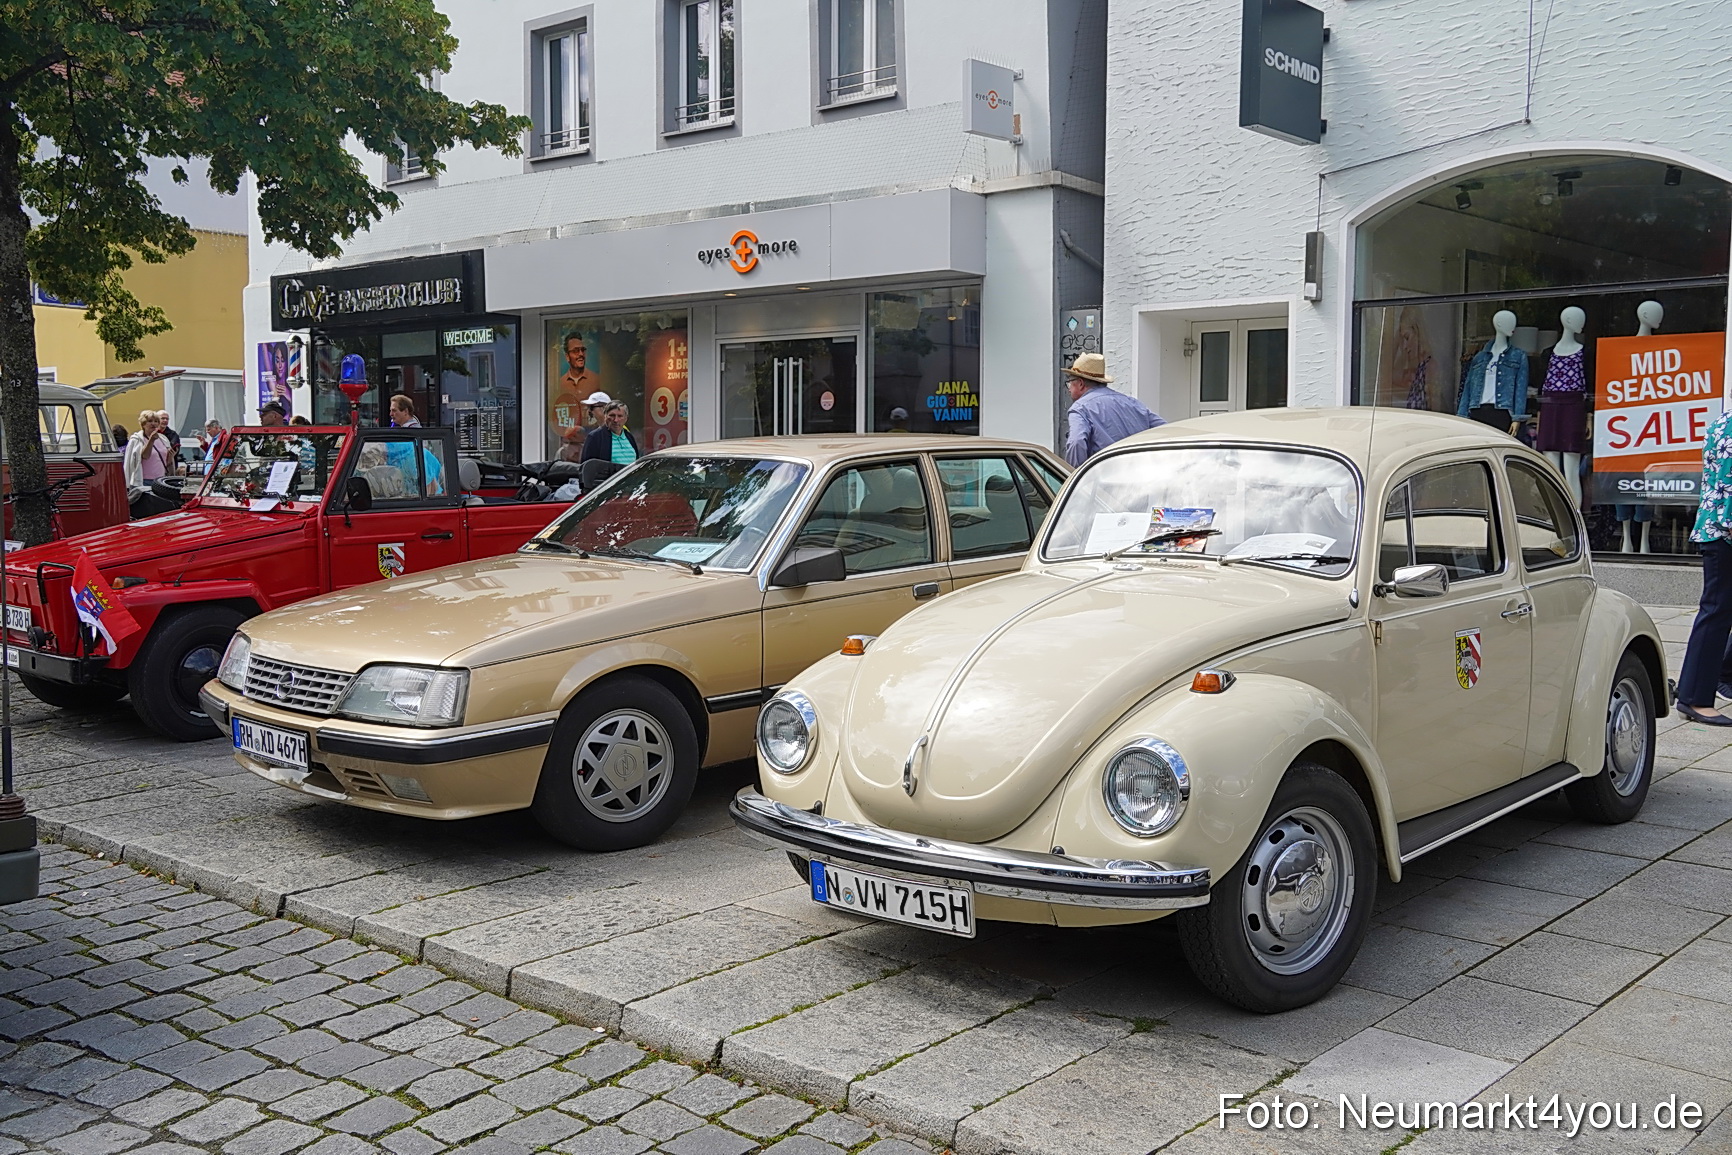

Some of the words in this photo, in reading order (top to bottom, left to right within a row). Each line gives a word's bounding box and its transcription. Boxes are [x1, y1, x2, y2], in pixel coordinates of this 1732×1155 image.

[1264, 47, 1320, 84] SCHMID
[975, 93, 989, 101] eyes
[998, 98, 1012, 107] more
[697, 247, 731, 264] eyes
[757, 239, 797, 254] more
[444, 329, 493, 345] WELCOME
[667, 358, 674, 370] 3
[1630, 348, 1682, 376] MID
[667, 372, 680, 380] ZUM
[10, 379, 21, 388] 13
[935, 381, 970, 394] JANA
[1606, 370, 1711, 404] SEASON
[657, 396, 668, 418] 3
[926, 395, 947, 408] GIO
[956, 394, 978, 407] INA
[555, 407, 570, 419] TEI
[933, 408, 972, 421] VANNI
[558, 417, 575, 428] LEN
[1607, 407, 1708, 449] SALE
[1617, 479, 1696, 491] SCHMID
[239, 723, 254, 749] RH
[260, 729, 275, 755] XD
[277, 733, 307, 763] 467H
[825, 869, 841, 902] N
[855, 877, 887, 912] VW
[895, 885, 969, 927] 715H
